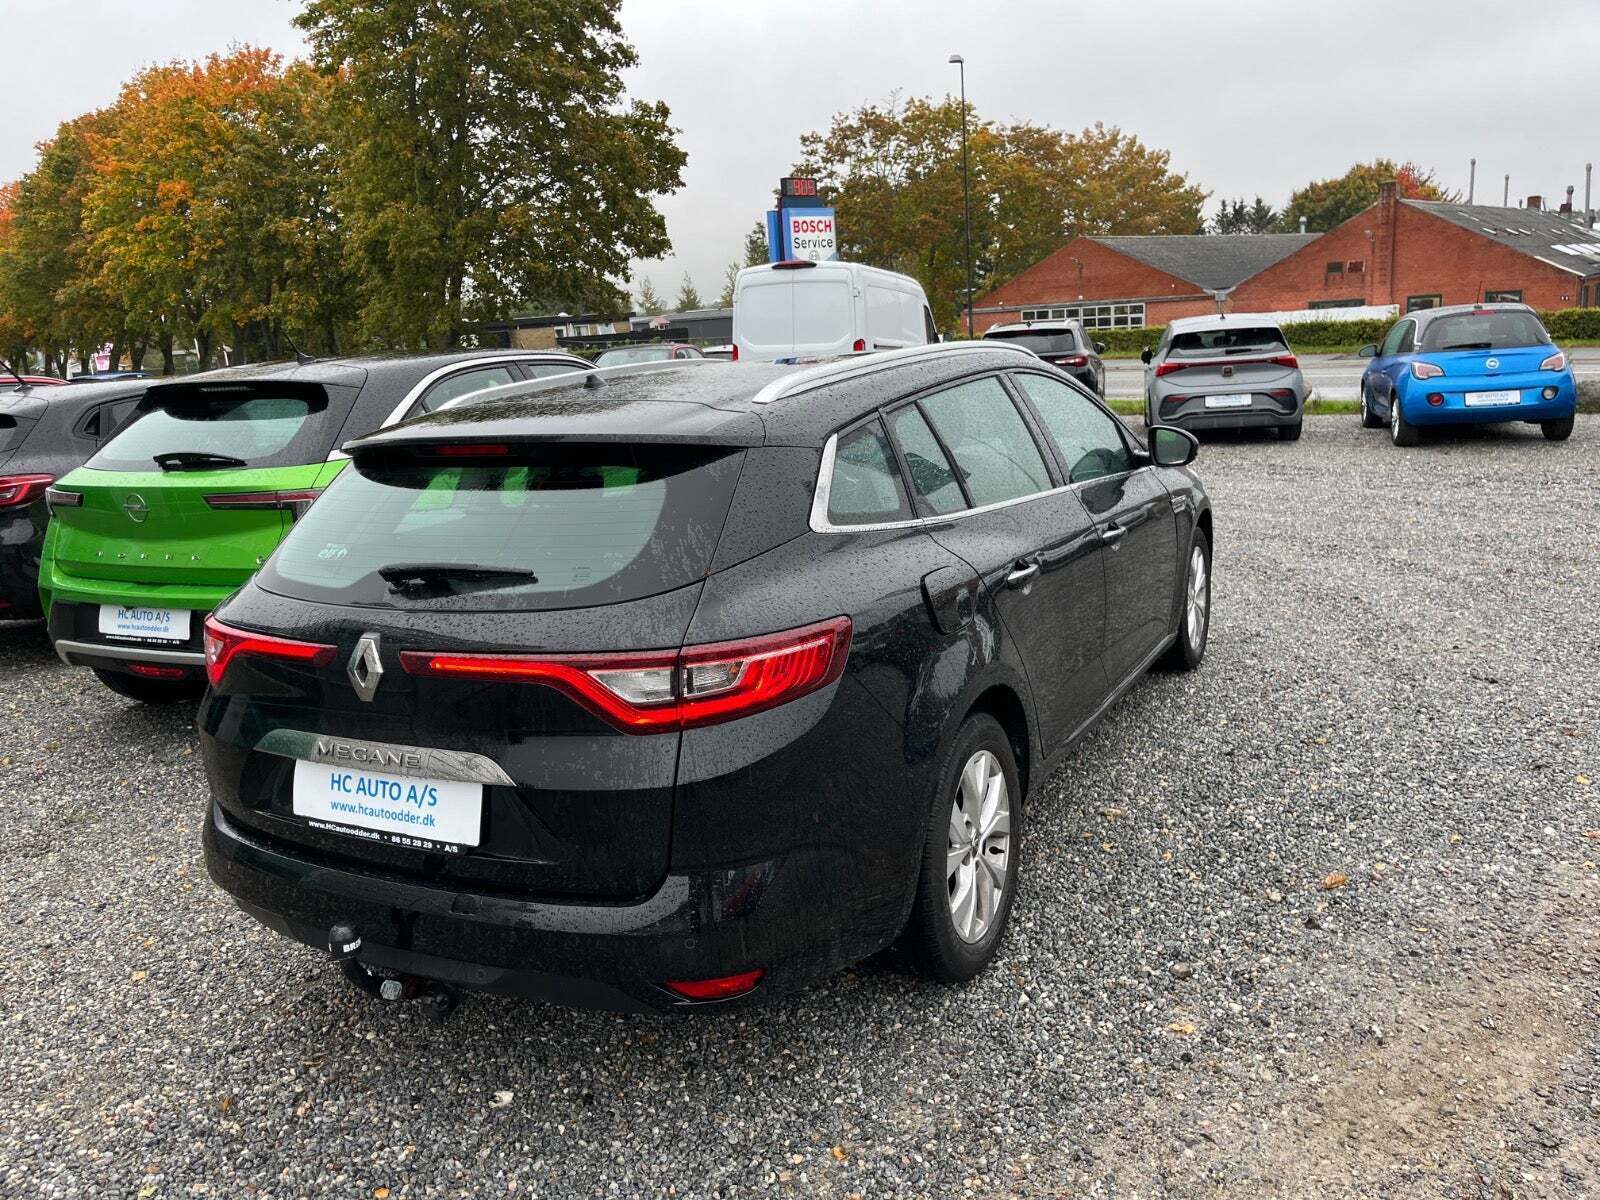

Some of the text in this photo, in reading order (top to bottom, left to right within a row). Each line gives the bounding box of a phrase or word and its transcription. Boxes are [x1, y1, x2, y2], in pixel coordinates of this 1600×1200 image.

[793, 220, 832, 233] BOSCH
[794, 236, 833, 248] Service
[131, 610, 153, 621] AUTO
[155, 612, 170, 624] A/S
[317, 741, 420, 768] MEGANE
[331, 773, 438, 808] HC AUTO A/S
[330, 799, 436, 828] www.hcautoodder.dk
[309, 820, 380, 840] www.HCautoodder.dk
[444, 844, 458, 853] A/S
